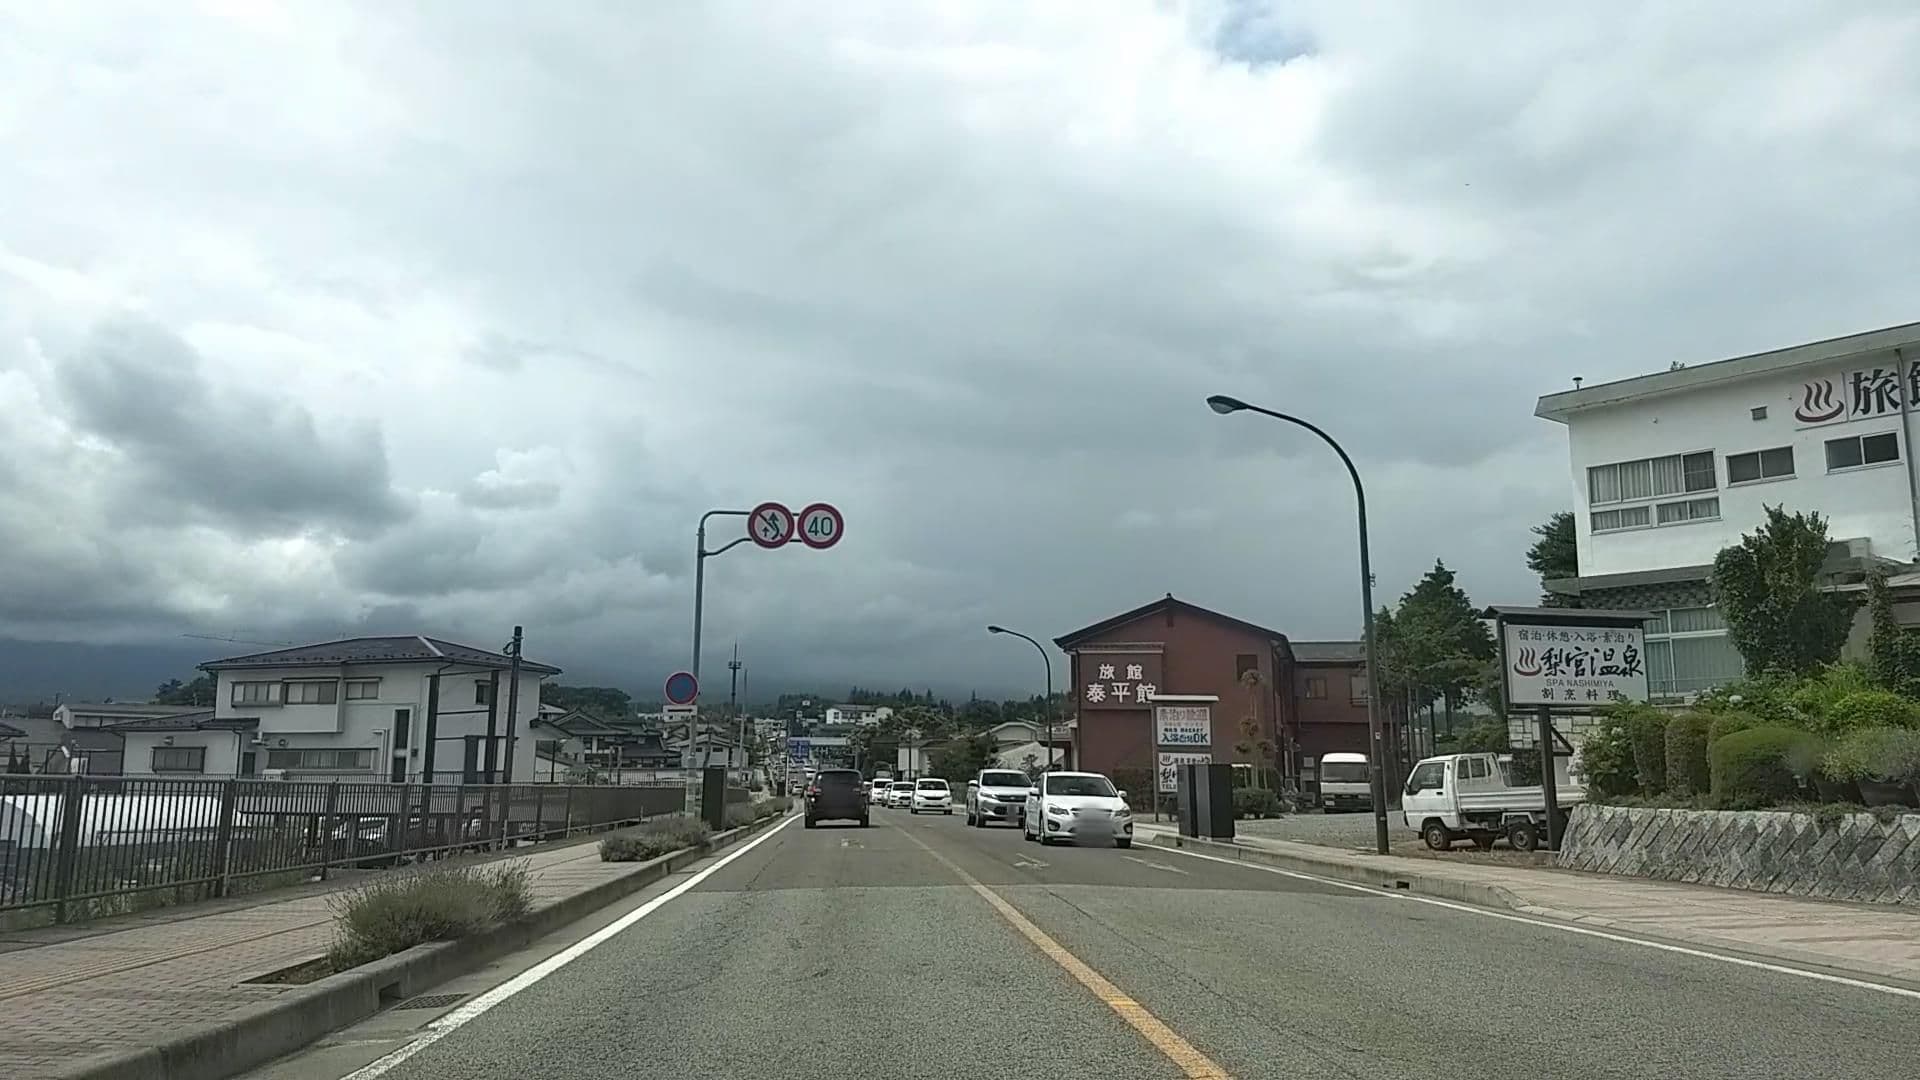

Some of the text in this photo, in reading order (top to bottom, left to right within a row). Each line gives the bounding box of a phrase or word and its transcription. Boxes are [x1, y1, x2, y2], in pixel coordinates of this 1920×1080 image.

[1849, 361, 1920, 416] 旅
[808, 516, 833, 536] 40
[1099, 663, 1143, 680] 旅館
[1086, 682, 1157, 704] 泰平館
